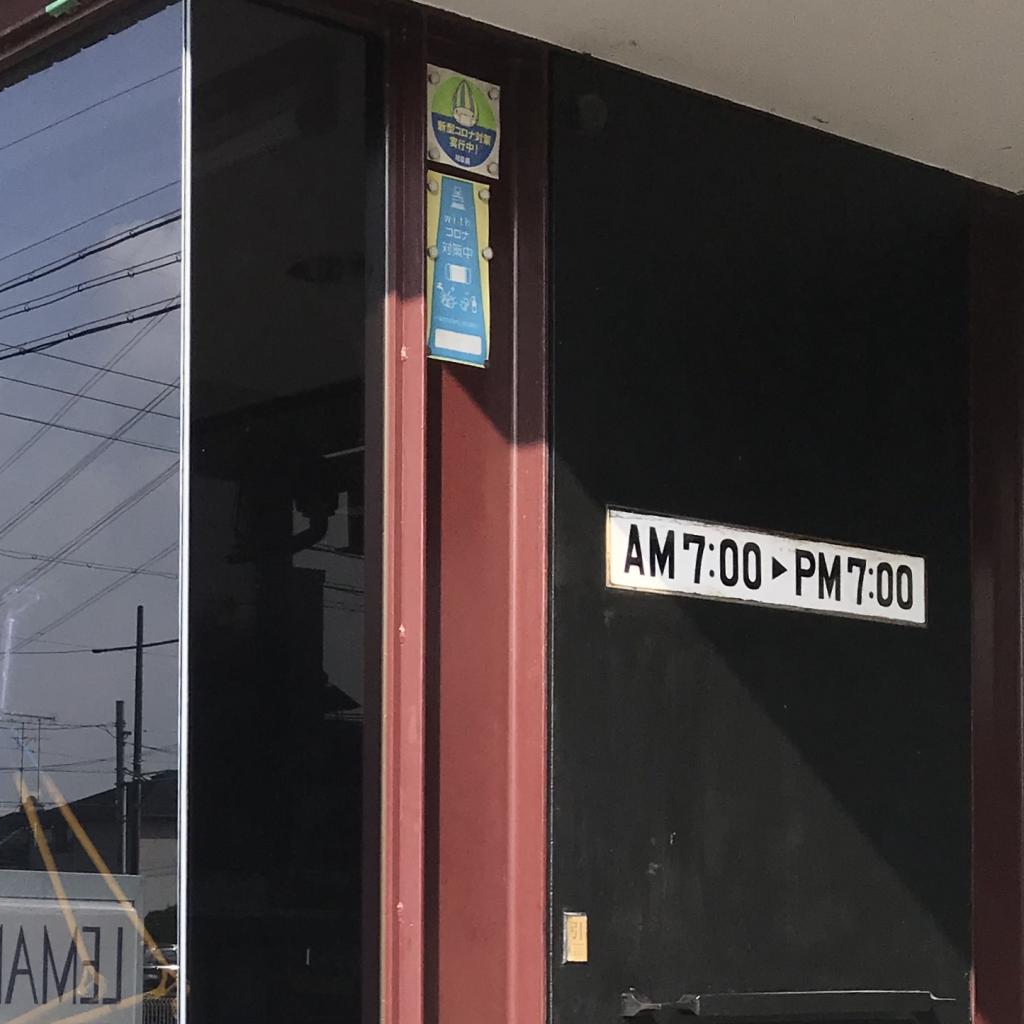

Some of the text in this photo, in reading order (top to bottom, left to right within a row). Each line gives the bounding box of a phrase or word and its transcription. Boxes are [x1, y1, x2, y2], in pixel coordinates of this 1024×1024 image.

[445, 227, 470, 240] コロナ
[441, 241, 473, 259] 対策中
